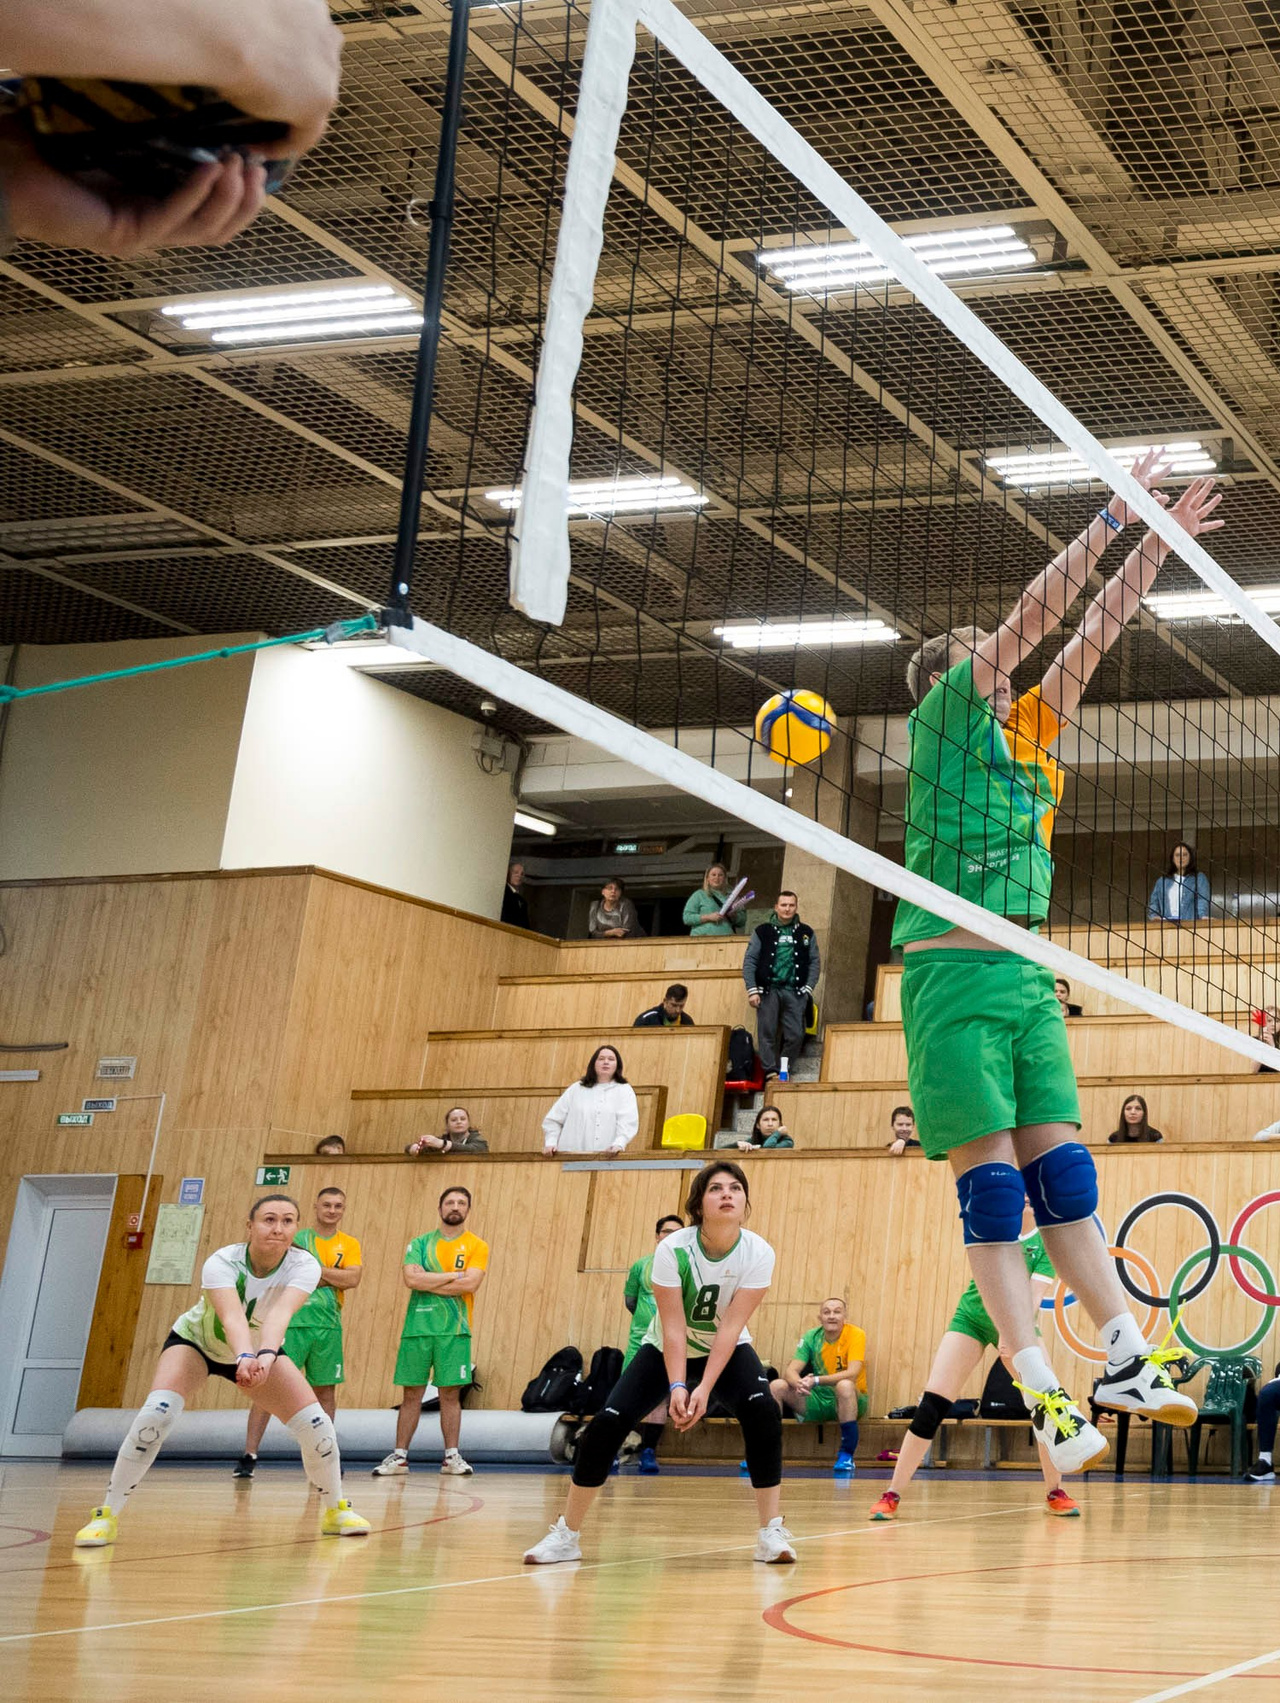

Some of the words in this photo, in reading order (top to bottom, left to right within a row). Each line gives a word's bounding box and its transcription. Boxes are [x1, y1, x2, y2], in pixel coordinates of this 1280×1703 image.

[967, 853, 1020, 873] ЭНРГИЙ
[455, 1254, 465, 1269] 6
[690, 1284, 720, 1322] 8
[459, 1365, 467, 1379] 6
